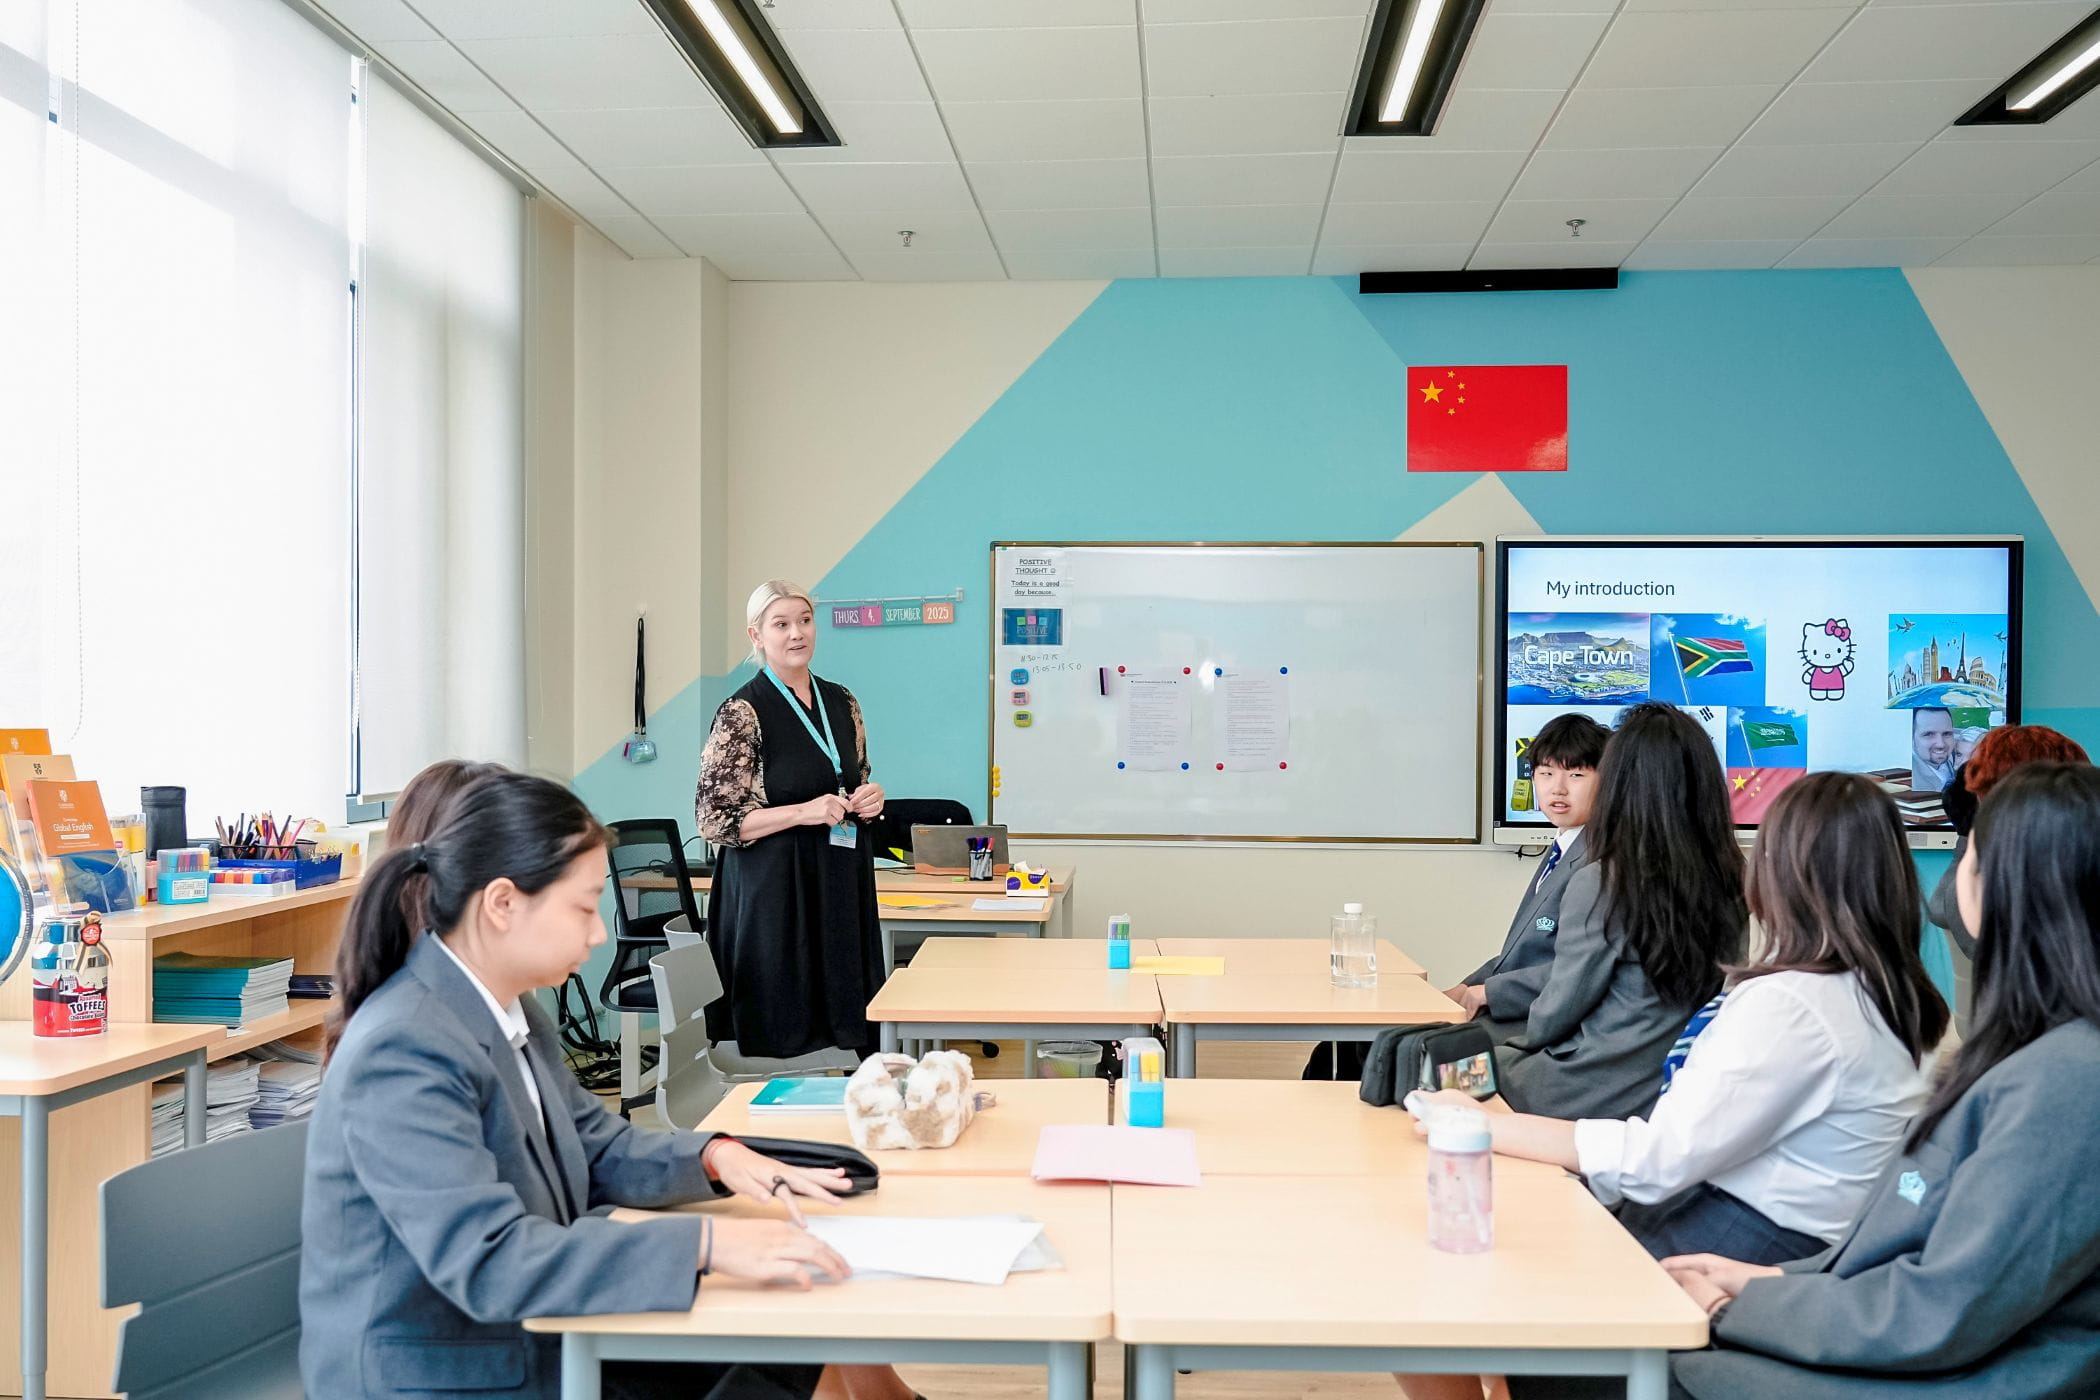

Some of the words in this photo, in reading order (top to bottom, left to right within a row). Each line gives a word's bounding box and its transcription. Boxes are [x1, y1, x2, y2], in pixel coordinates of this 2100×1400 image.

[1011, 580, 1030, 588] Today
[1546, 581, 1571, 598] My
[1575, 581, 1675, 596] introduction
[1014, 589, 1026, 597] day
[885, 607, 921, 622] SEPTEMBER
[927, 606, 949, 619] 2025
[1524, 644, 1575, 671] Cape
[1579, 645, 1633, 665] Town
[53, 823, 71, 832] Global
[71, 822, 94, 833] English
